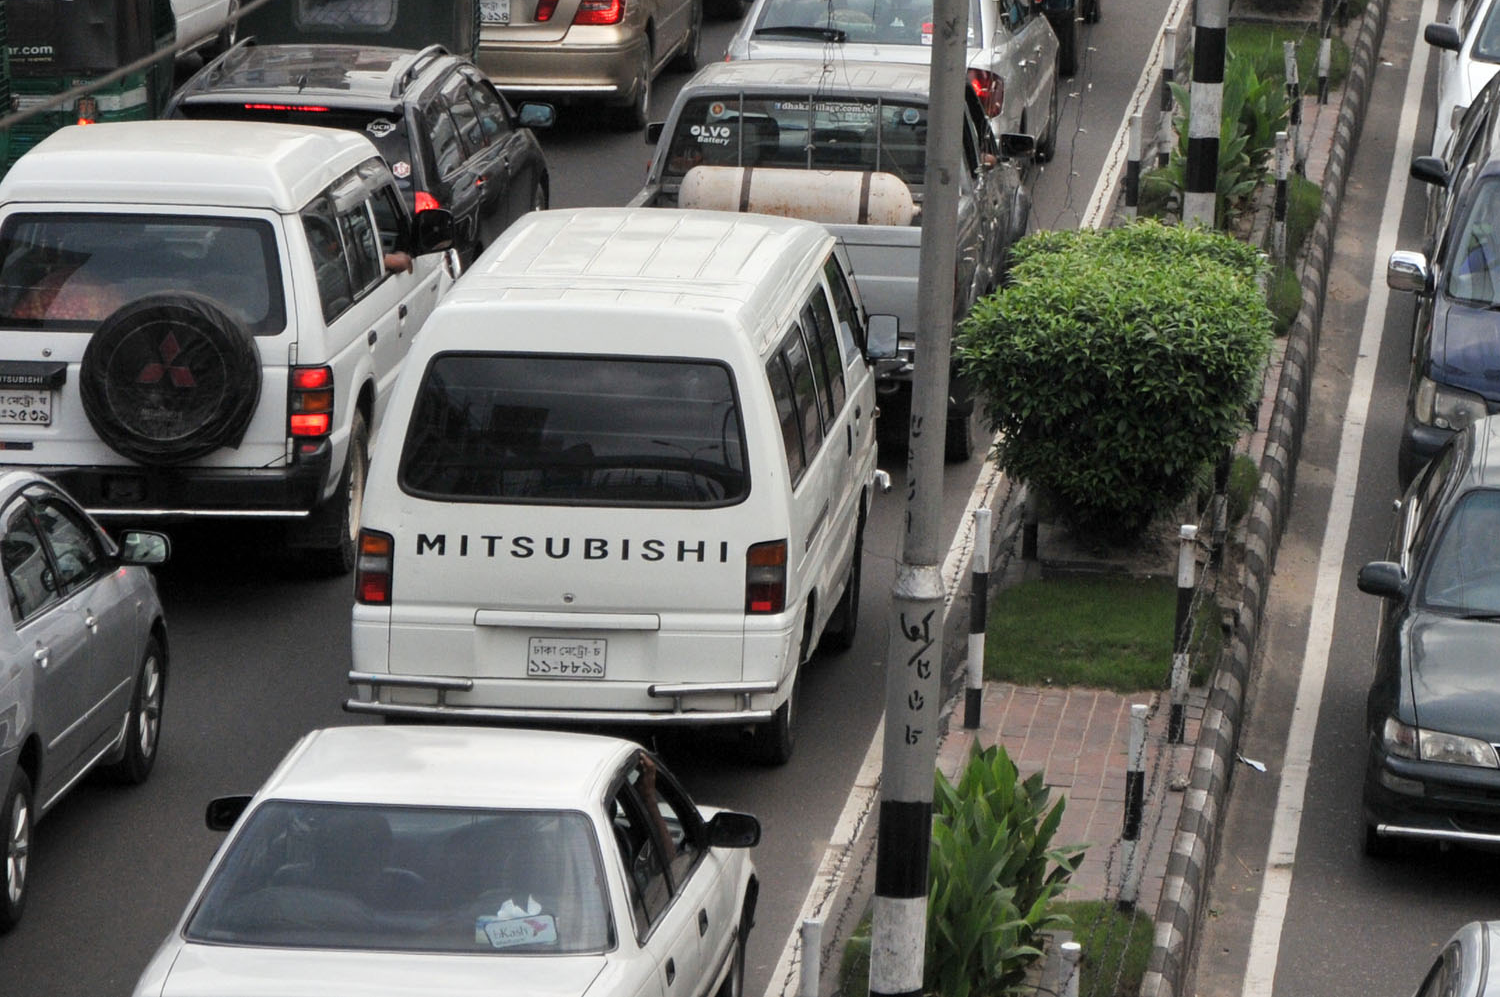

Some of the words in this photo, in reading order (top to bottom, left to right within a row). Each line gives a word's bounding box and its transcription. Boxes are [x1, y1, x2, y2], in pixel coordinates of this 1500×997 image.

[781, 103, 874, 114] dhakaillage.com.bd
[697, 136, 730, 146] Battery
[416, 533, 729, 563] MITSUBISHI
[533, 645, 557, 656] ঢাকা
[529, 659, 603, 675] ১১-৮৮৯৯
